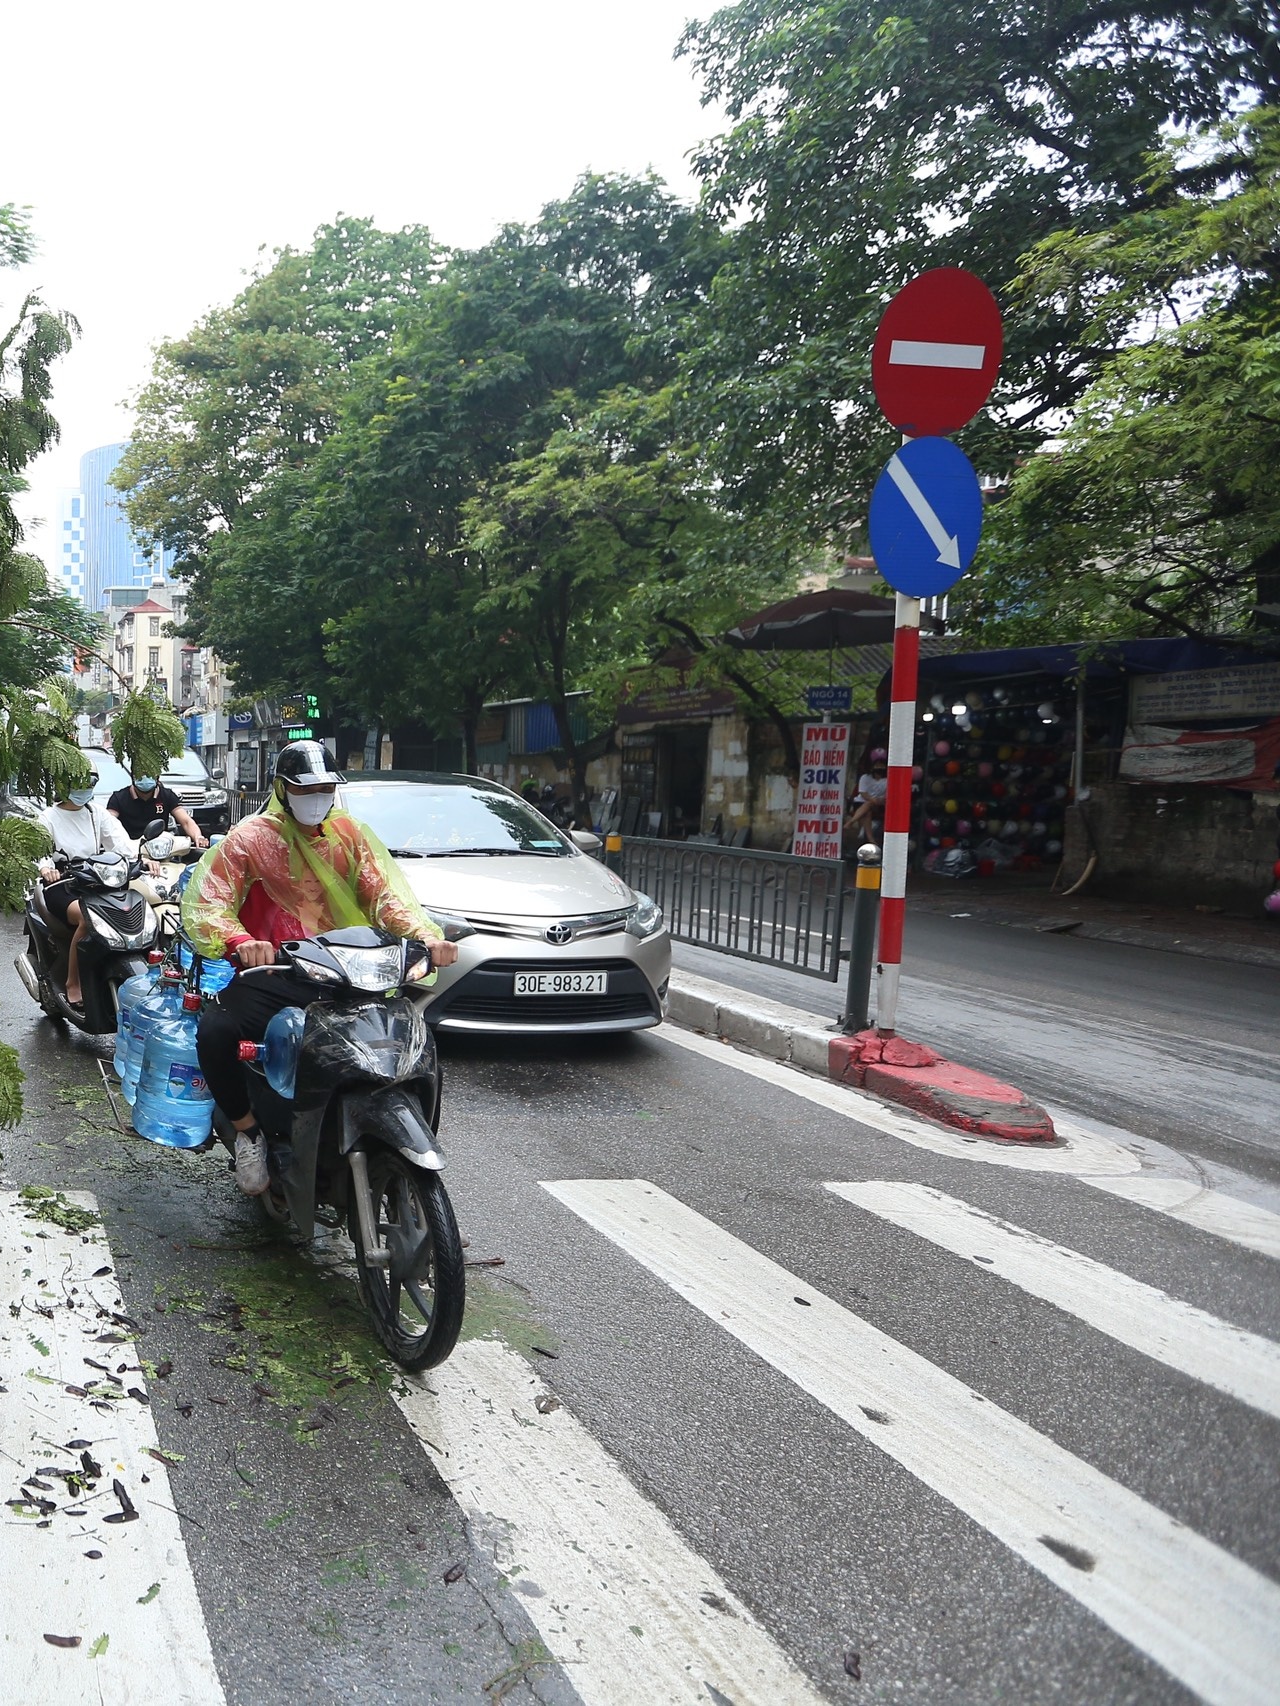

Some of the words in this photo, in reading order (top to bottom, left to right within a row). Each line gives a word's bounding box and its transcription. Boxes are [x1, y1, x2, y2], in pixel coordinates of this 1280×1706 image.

[806, 725, 847, 742] MŨ
[803, 744, 821, 766] BẢO
[823, 743, 845, 767] HIỂM
[803, 769, 841, 785] 30K
[798, 804, 818, 815] THAY
[797, 818, 839, 834] MŨ
[795, 836, 813, 857] BẢO
[815, 835, 839, 859] HIỂM
[517, 974, 604, 993] 30E-983.21
[358, 1002, 388, 1010] HONDA
